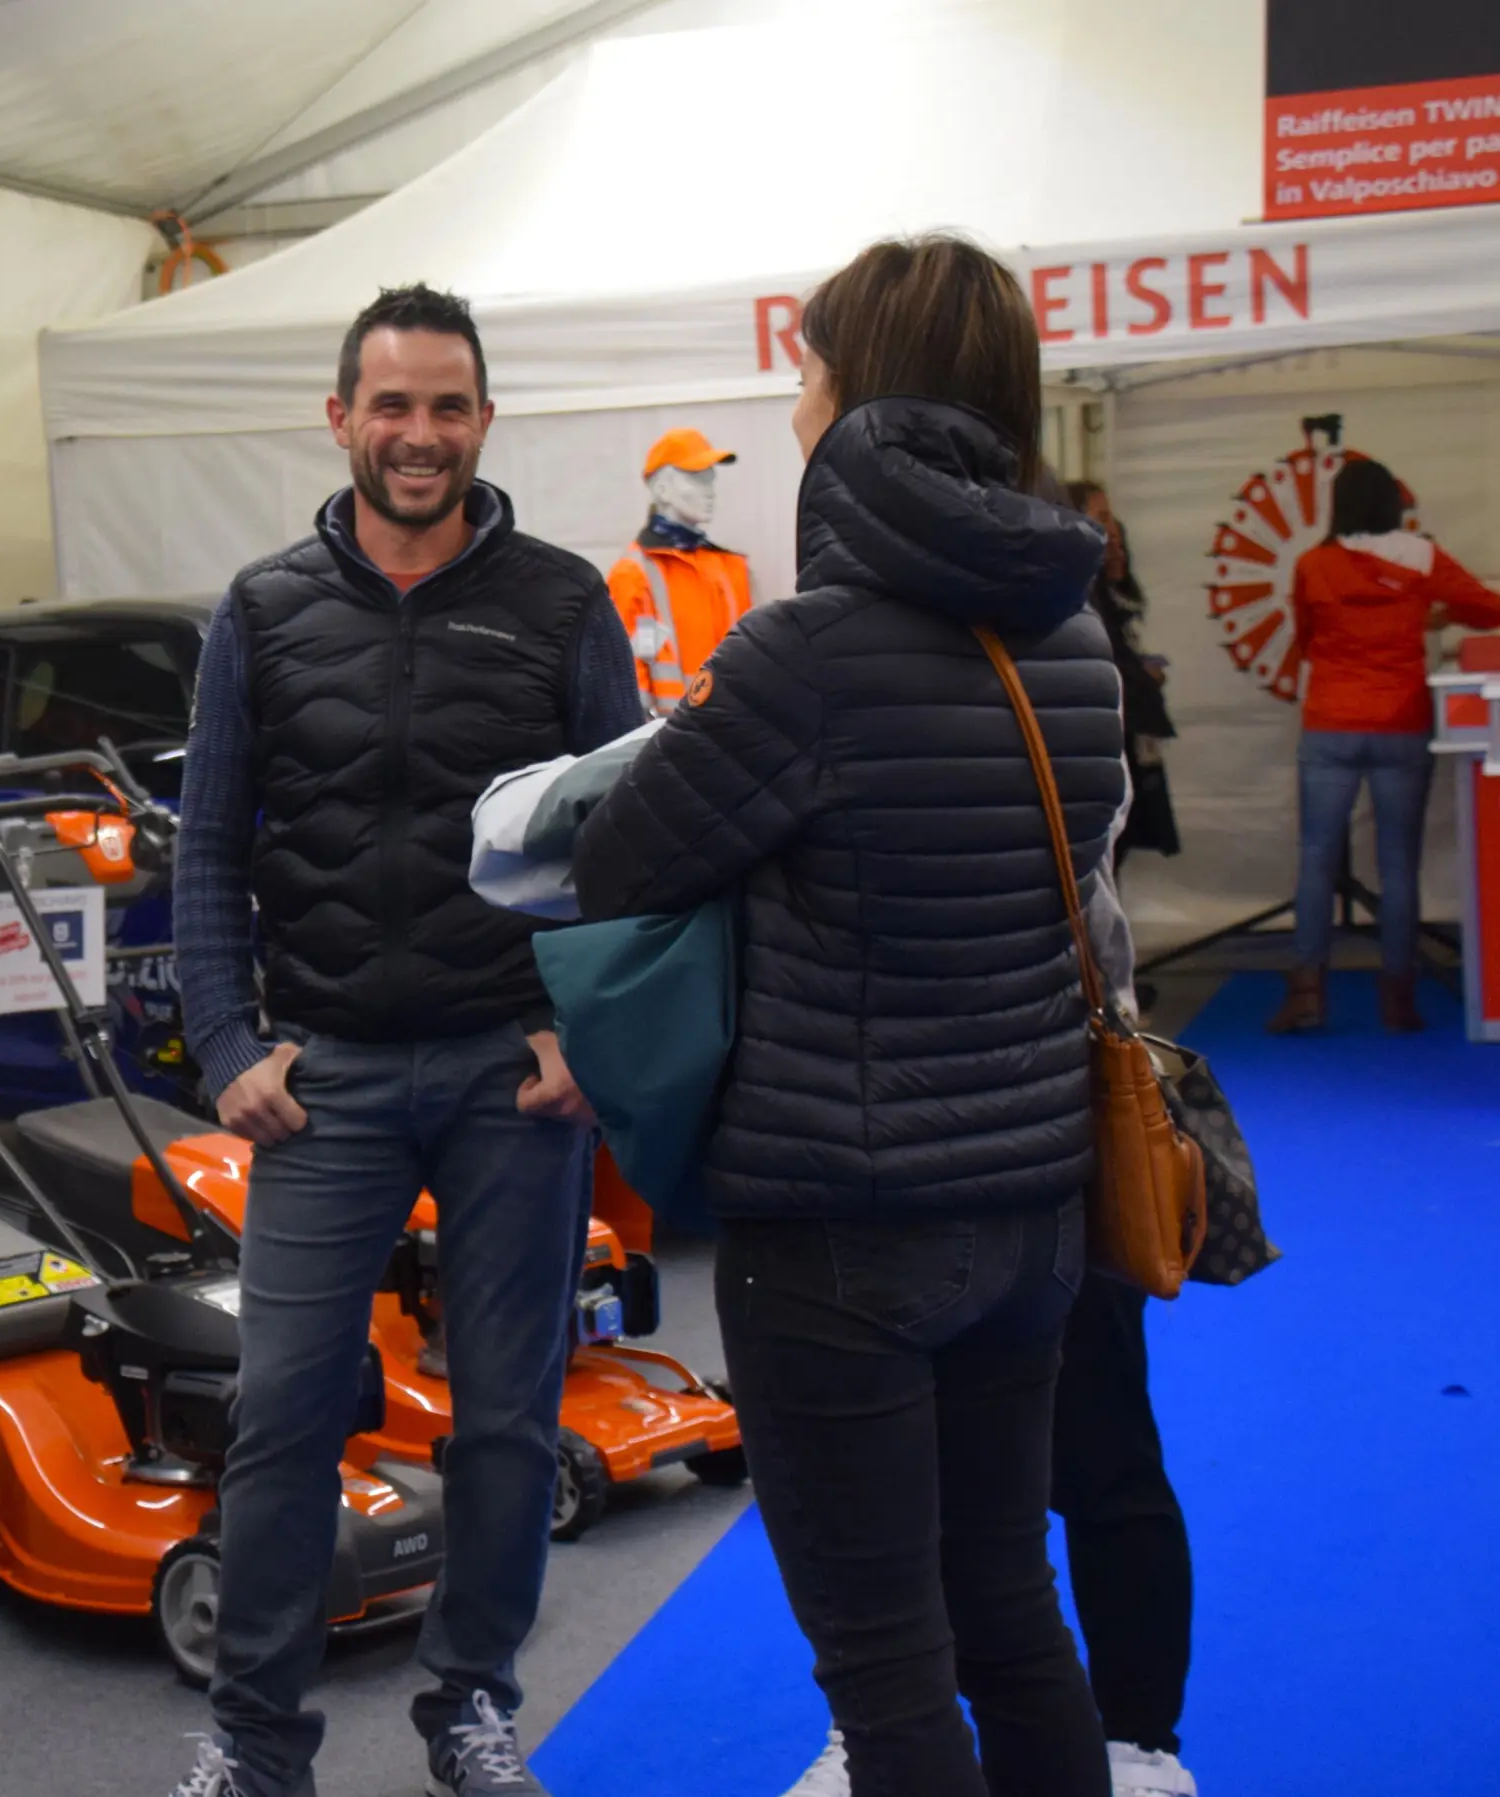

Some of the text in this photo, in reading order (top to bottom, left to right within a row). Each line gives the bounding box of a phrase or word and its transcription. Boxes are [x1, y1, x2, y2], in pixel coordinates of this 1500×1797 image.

[1276, 106, 1416, 138] Raiffeisen
[1276, 141, 1402, 172] Semplice
[1408, 138, 1458, 166] per
[1276, 168, 1498, 206] in Valposchiavo
[754, 244, 1310, 372] REISEN
[393, 1532, 429, 1558] AWD
